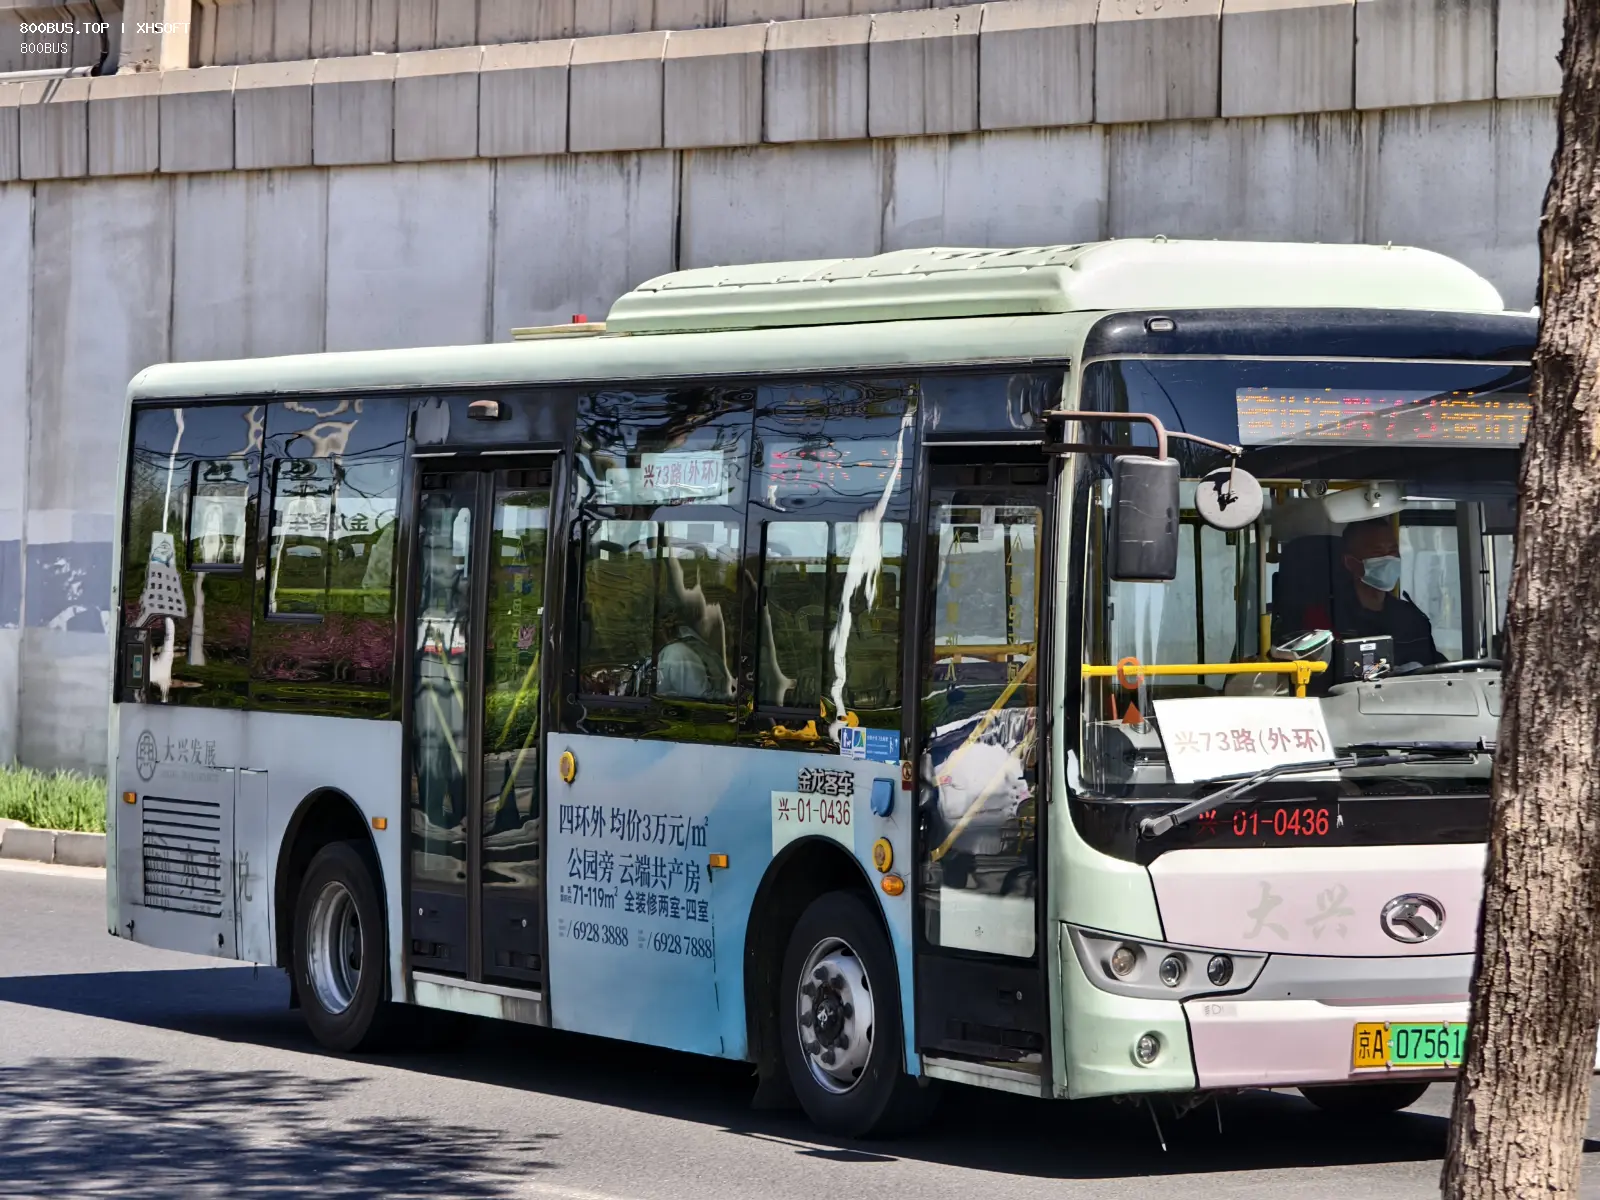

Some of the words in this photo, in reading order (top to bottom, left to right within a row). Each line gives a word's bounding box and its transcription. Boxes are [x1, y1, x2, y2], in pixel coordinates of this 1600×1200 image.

[163, 735, 217, 766] 大兴发展
[1173, 727, 1326, 754] 兴73路(外环)
[798, 767, 854, 797] 金龙客车
[559, 803, 606, 838] 四环外
[778, 796, 850, 825] 兴-01-0436
[567, 847, 614, 884] 公园旁
[619, 853, 701, 894] 云端共产房
[1242, 880, 1356, 941] 大兴
